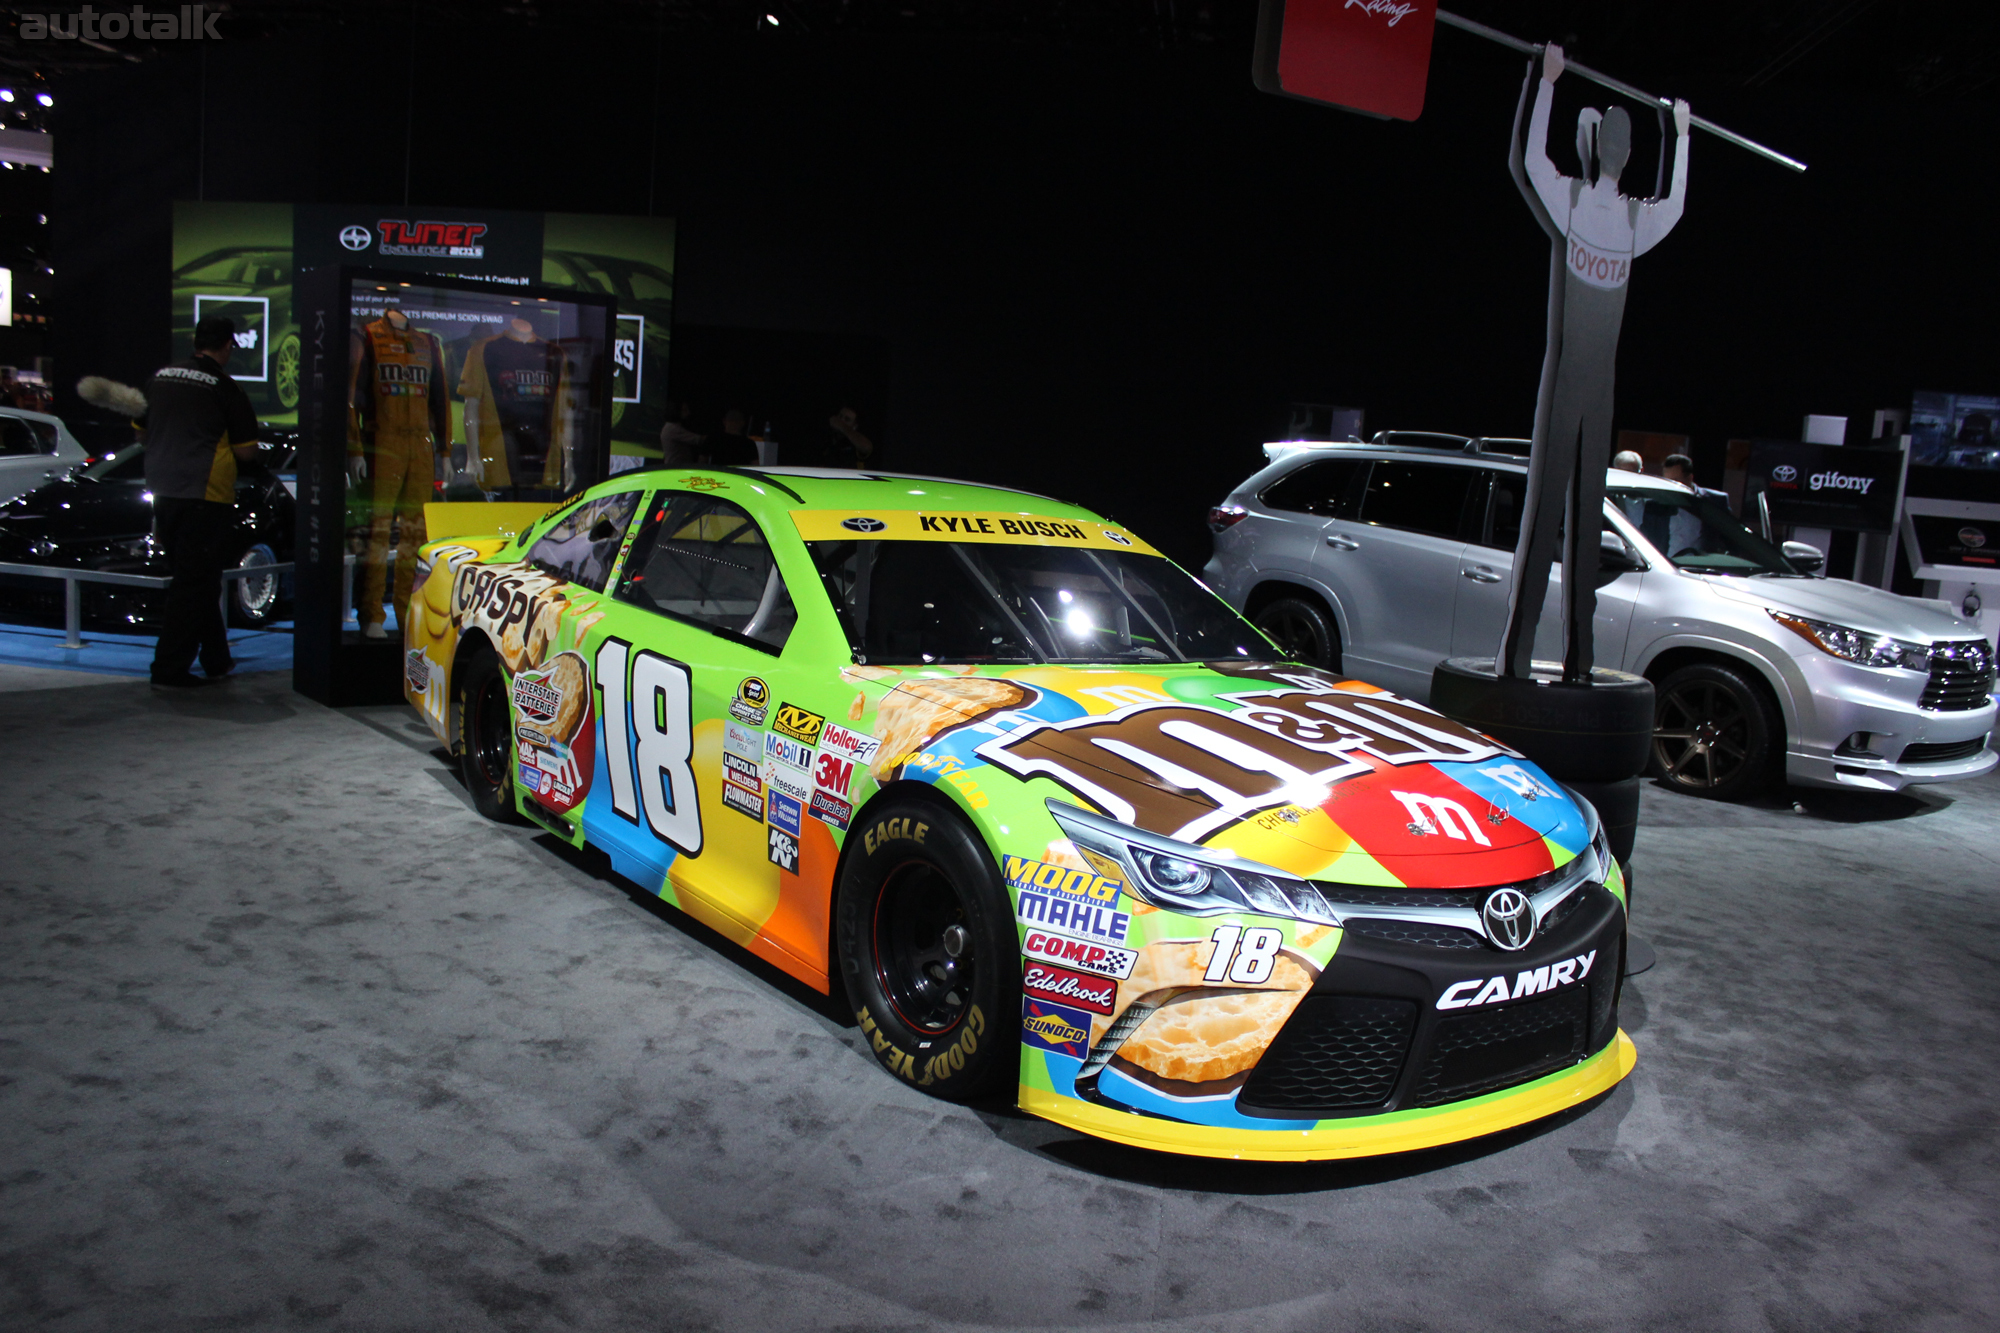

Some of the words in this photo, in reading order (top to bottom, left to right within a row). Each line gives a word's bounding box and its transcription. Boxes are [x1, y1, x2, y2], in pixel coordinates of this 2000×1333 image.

[449, 245, 483, 258] 2015
[1570, 238, 1627, 282] TOYOTA
[421, 310, 457, 321] PREMIUM
[457, 312, 481, 323] SCION
[481, 314, 504, 325] SWAG
[313, 310, 326, 391] KYLE
[613, 338, 635, 372] KS
[155, 367, 219, 385] MOTHERS
[1808, 470, 1876, 495] gifony
[919, 516, 996, 534] KYLE
[998, 518, 1088, 540] BUSCH
[458, 566, 549, 649] CRISPY
[514, 678, 560, 705] INTERSTATE
[514, 693, 557, 717] BATTERIES
[731, 706, 751, 717] SPRINT
[750, 713, 763, 721] CUP
[735, 702, 756, 714] CHASE
[773, 720, 800, 739] MECHANIX
[799, 734, 816, 745] WEAR
[822, 723, 860, 757] Holley
[852, 741, 880, 760] EFI
[595, 635, 704, 860] 18
[766, 734, 799, 763] Mobil
[724, 752, 757, 777] LINCOLN
[815, 753, 854, 797] 3M
[731, 770, 759, 790] WELDERS
[773, 775, 807, 800] freescale
[724, 783, 763, 814] FLOWMASTER
[814, 794, 850, 820] Duralast
[821, 813, 840, 827] BRAKES
[864, 818, 930, 856] EAGLE
[1004, 856, 1121, 903] MOOG
[1007, 879, 1042, 893] STEERING
[1056, 891, 1106, 907] SUSPENSION
[1017, 891, 1130, 941] MAHLE
[1026, 933, 1106, 963] COMP
[1068, 929, 1092, 940] ENGINE
[1092, 934, 1124, 947] BEARINGS
[1077, 960, 1118, 974] CAMS
[1202, 924, 1284, 984] 18
[1024, 968, 1113, 1007] Edelbrock
[1435, 949, 1597, 1011] CAMRY
[1025, 1017, 1085, 1042] SUNOCO
